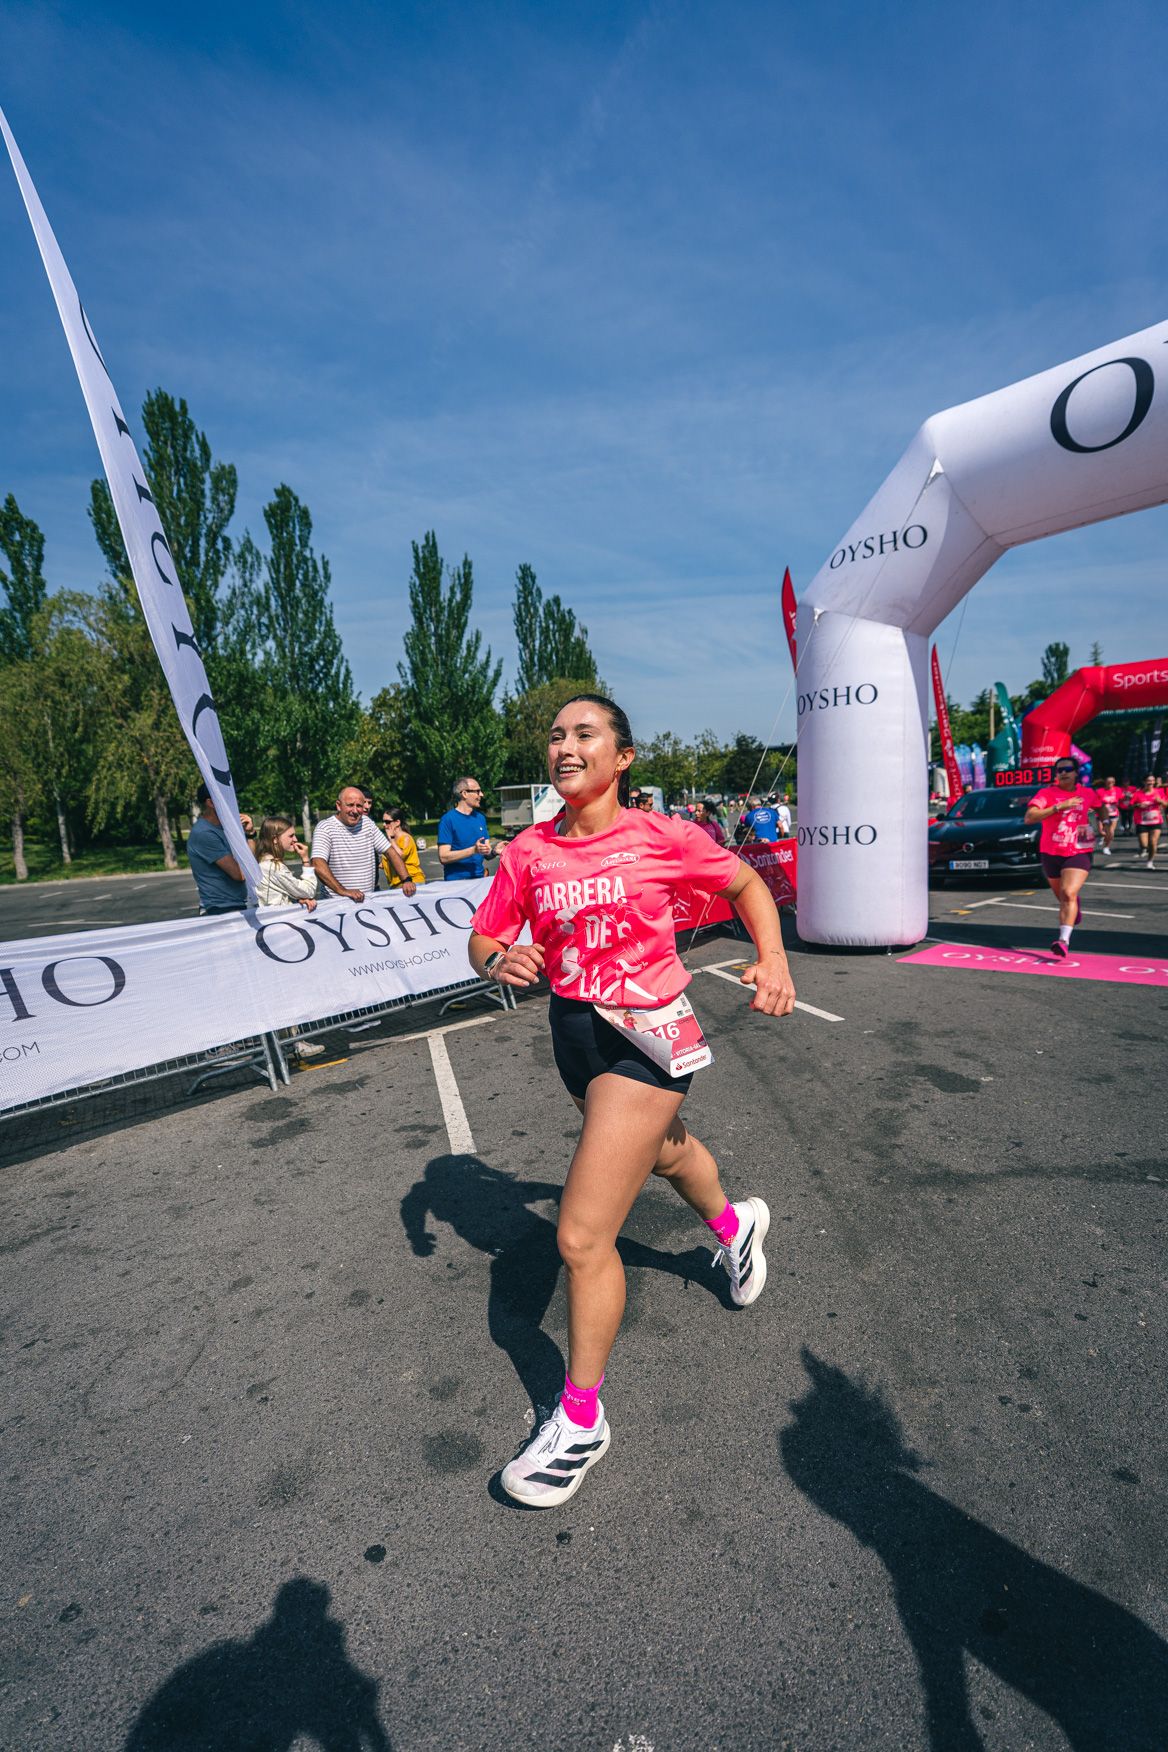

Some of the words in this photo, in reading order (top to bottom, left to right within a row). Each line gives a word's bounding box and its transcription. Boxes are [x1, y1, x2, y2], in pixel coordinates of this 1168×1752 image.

[1050, 340, 1168, 453] O
[830, 525, 928, 570] OYSHO
[1112, 668, 1168, 689] Sports
[797, 683, 878, 715] OYSHO
[797, 824, 878, 847] OYSHO
[749, 848, 794, 868] Santander
[535, 876, 628, 914] CARRERA
[255, 896, 479, 964] OYSHO
[585, 914, 613, 949] DE
[348, 947, 451, 977] WWW.OYSHO.COM
[579, 964, 601, 999] LA
[0, 1041, 40, 1062] OM
[682, 1054, 707, 1068] Santander
